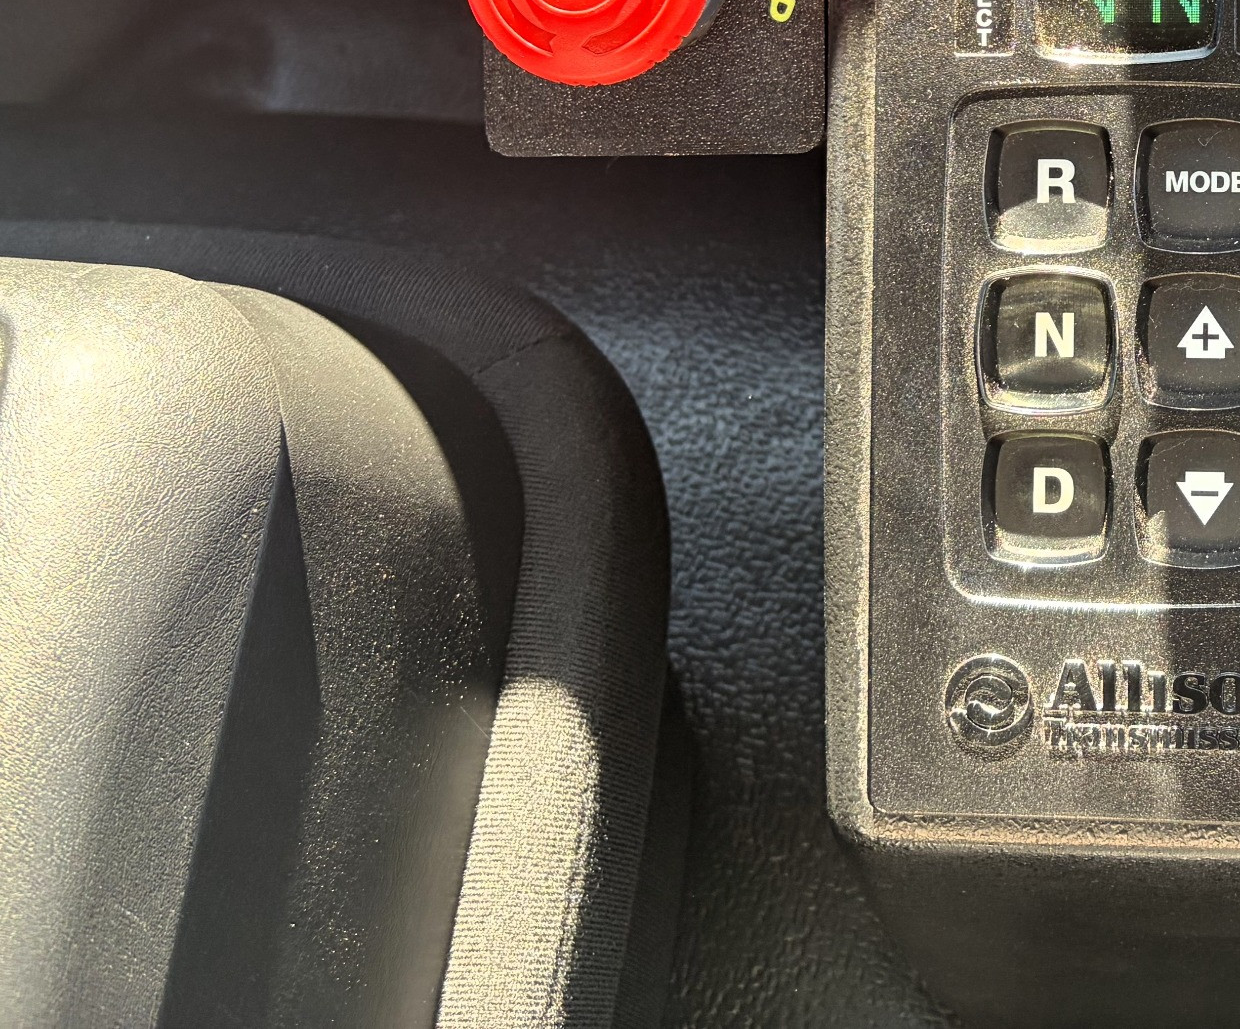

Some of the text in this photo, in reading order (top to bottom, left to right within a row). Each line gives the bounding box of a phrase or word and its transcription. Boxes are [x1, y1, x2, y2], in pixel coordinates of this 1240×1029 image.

[1036, 158, 1077, 204] R
[1034, 311, 1076, 358] N
[1031, 466, 1075, 514] D
